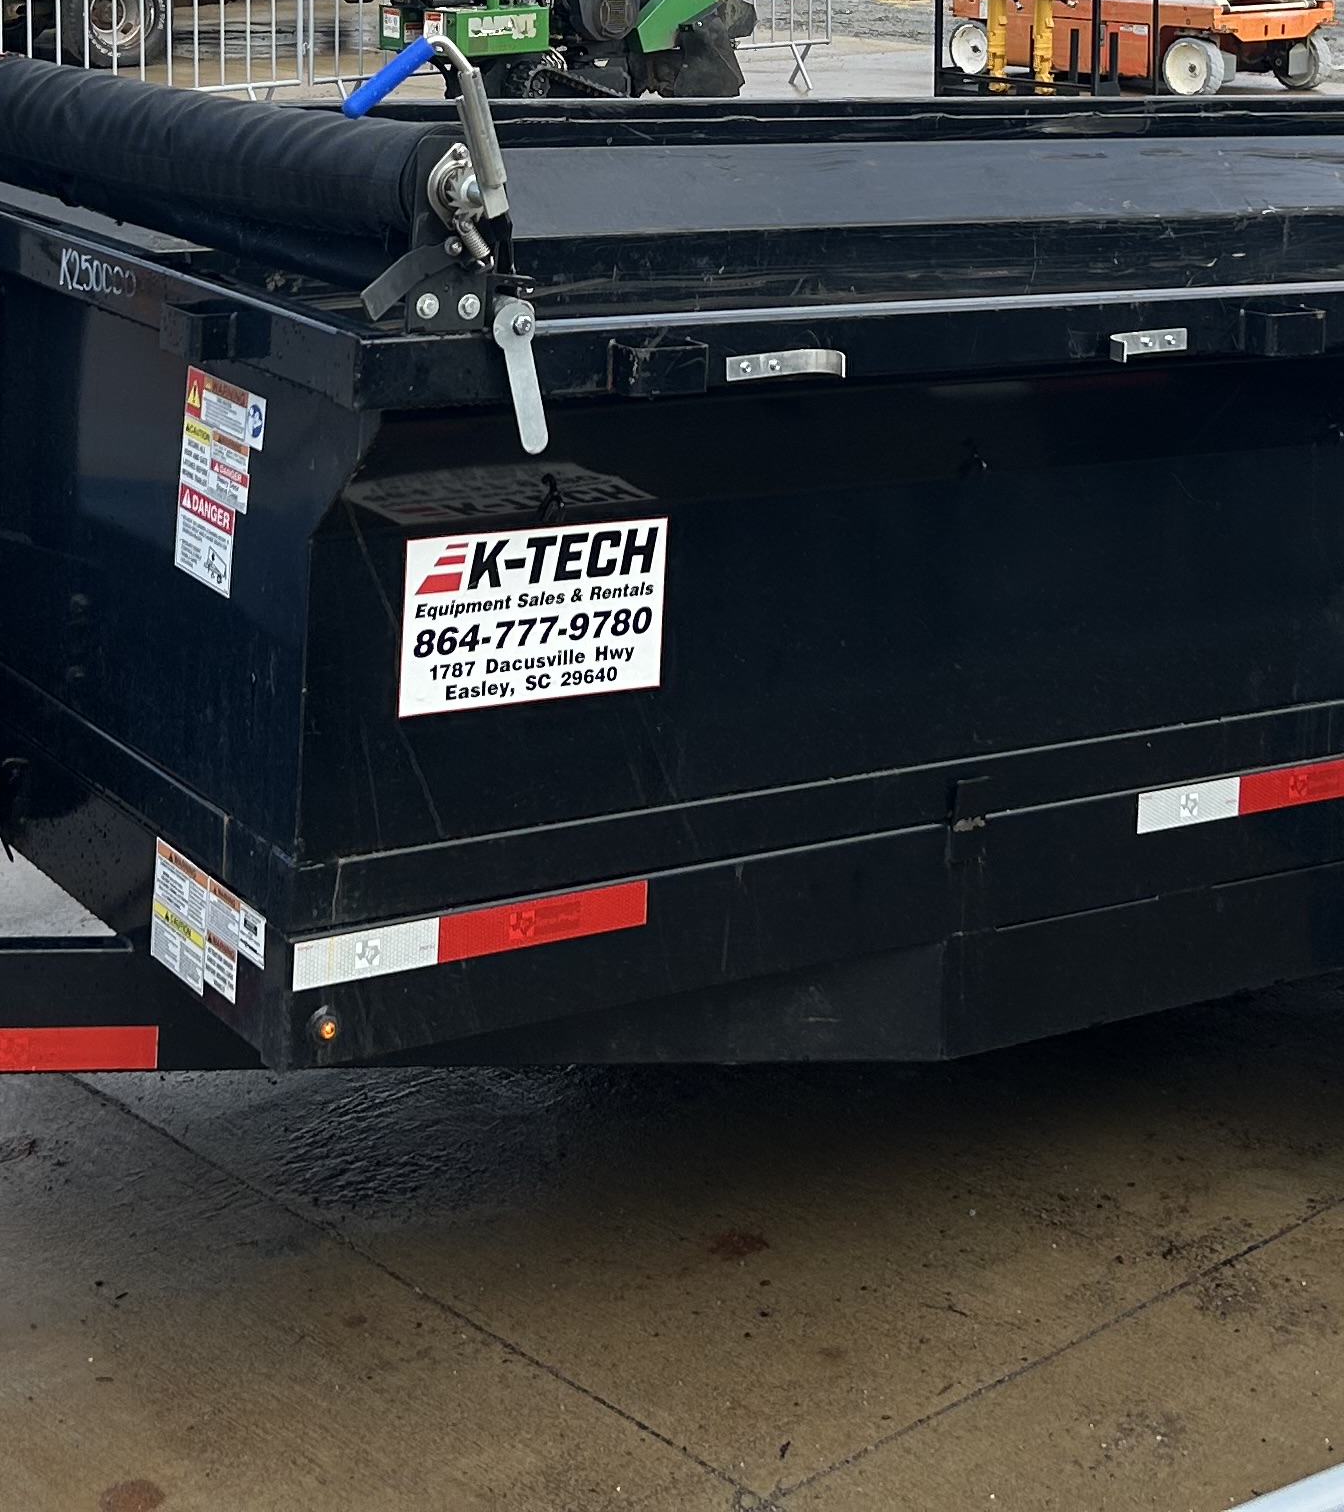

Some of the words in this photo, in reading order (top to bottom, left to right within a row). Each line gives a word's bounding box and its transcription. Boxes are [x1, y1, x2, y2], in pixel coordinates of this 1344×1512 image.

[192, 494, 230, 530] DANGER
[467, 526, 659, 590] K-TECH
[415, 595, 511, 620] Equipment
[517, 591, 565, 608] Sales
[570, 589, 583, 603] &
[589, 581, 654, 601] Rentals
[413, 606, 653, 658] 864-777-9780
[430, 661, 476, 681] 1787
[486, 649, 585, 675] Dacusville
[595, 645, 634, 662] Hwy
[445, 680, 515, 701] Easley,
[525, 674, 551, 691] SC
[561, 666, 618, 687] 29640
